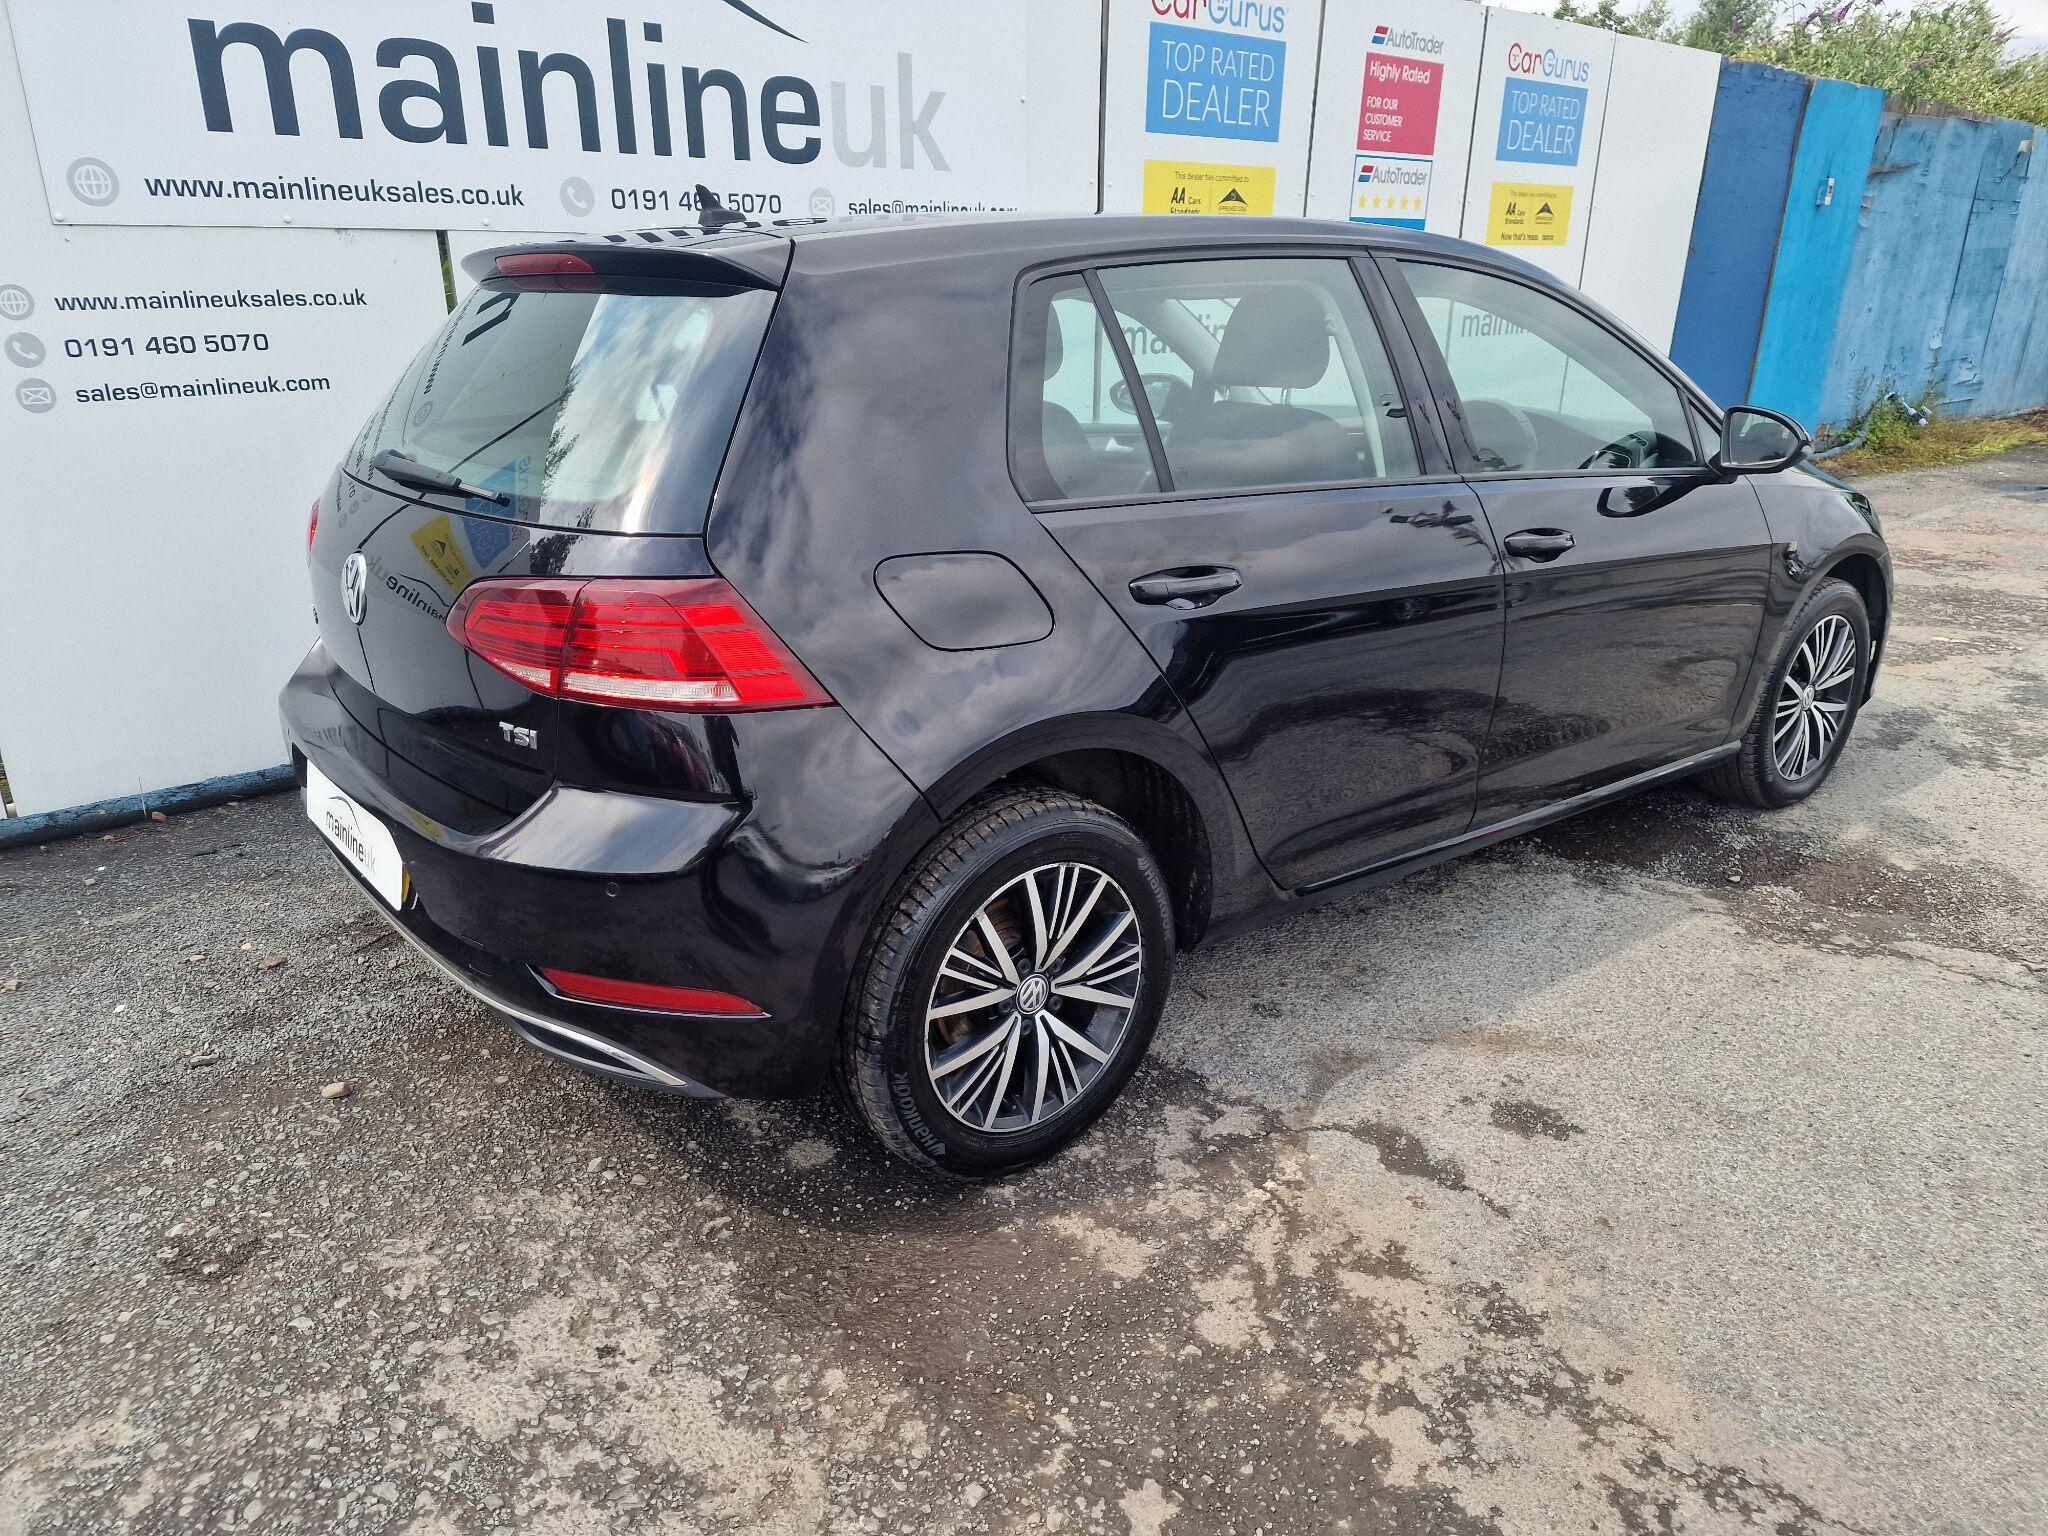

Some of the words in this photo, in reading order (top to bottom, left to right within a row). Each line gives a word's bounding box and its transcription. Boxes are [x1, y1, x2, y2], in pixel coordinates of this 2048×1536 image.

[1386, 28, 1444, 55] AutoTrader
[1162, 40, 1206, 73] TOP
[1211, 47, 1275, 82] RATED
[1370, 60, 1401, 83] Highly
[1402, 65, 1431, 84] Rated
[1508, 42, 1590, 82] CarGurus
[187, 1, 951, 172] mainlineuk
[1162, 79, 1270, 128] DEALER
[1367, 96, 1382, 108] FOR
[1383, 98, 1399, 111] OUR
[1512, 90, 1538, 114] TOP
[1540, 94, 1580, 120] RATED
[1365, 112, 1403, 127] CUSTOMER
[1363, 129, 1392, 142] SERVICE
[1507, 119, 1575, 155] DEALER
[1175, 171, 1186, 180] This
[1372, 166, 1428, 186] AutoTrader
[144, 176, 525, 207] www.mainlineuksales.co.uk
[611, 187, 671, 212] 0191
[727, 191, 782, 215] 5070
[1170, 187, 1186, 204] AA
[1188, 197, 1202, 205] Cars
[54, 289, 368, 311] www.mainlineuksales.co.uk
[64, 337, 136, 358] 0191
[145, 335, 198, 356] 460
[203, 333, 270, 354] 5070
[76, 376, 331, 403] sales@mainlineuk.com
[499, 721, 538, 750] TSI
[325, 810, 376, 877] mainlineuk
